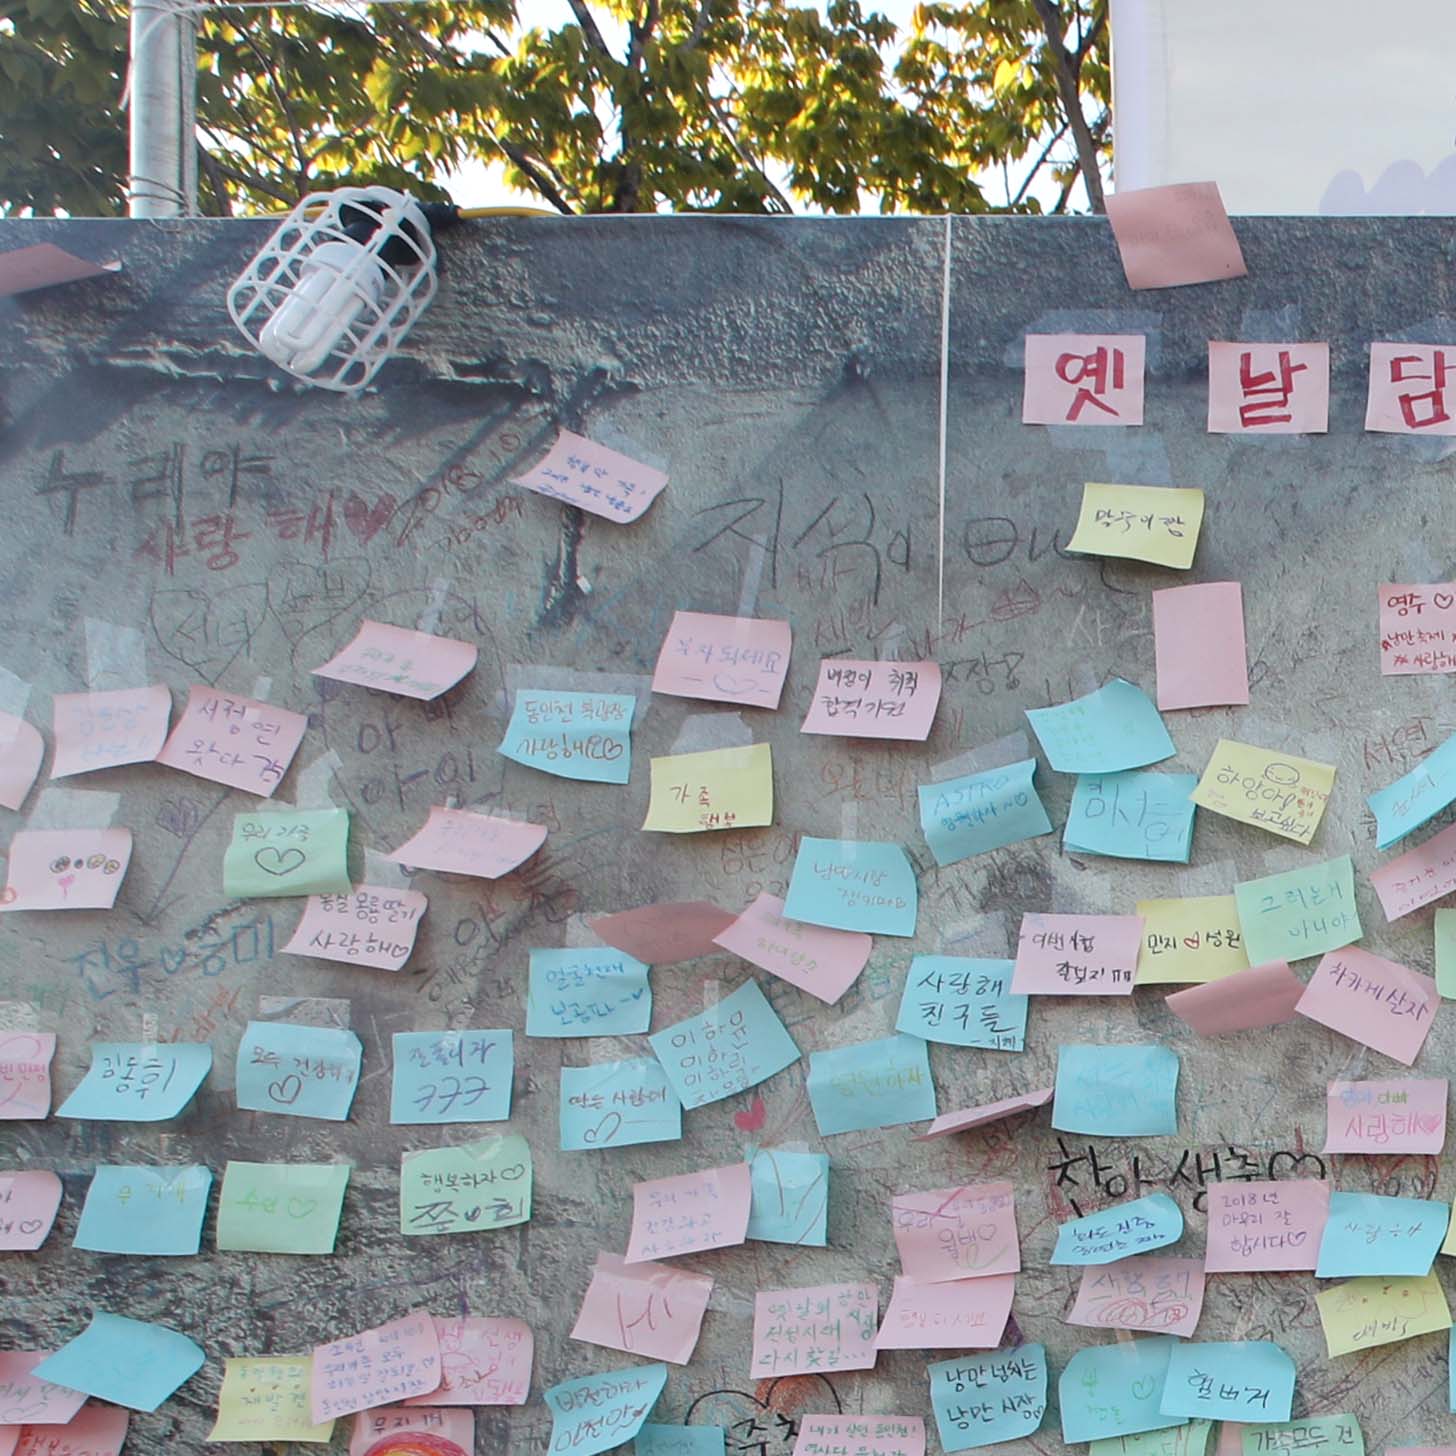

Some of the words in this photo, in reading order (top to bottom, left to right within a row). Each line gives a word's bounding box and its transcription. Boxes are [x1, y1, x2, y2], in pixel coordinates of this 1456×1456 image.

[672, 785, 710, 806] 가족
[310, 935, 392, 954] 사랑해
[1148, 933, 1176, 953] 민지
[1206, 931, 1240, 948] 성원
[916, 972, 1004, 997] 사랑해
[918, 1001, 1018, 1033] 친구들
[1346, 1114, 1422, 1141] 사랑해
[945, 1368, 986, 1386] 낭만
[948, 1407, 993, 1429] 낭만
[1002, 1397, 1036, 1418] 시장
